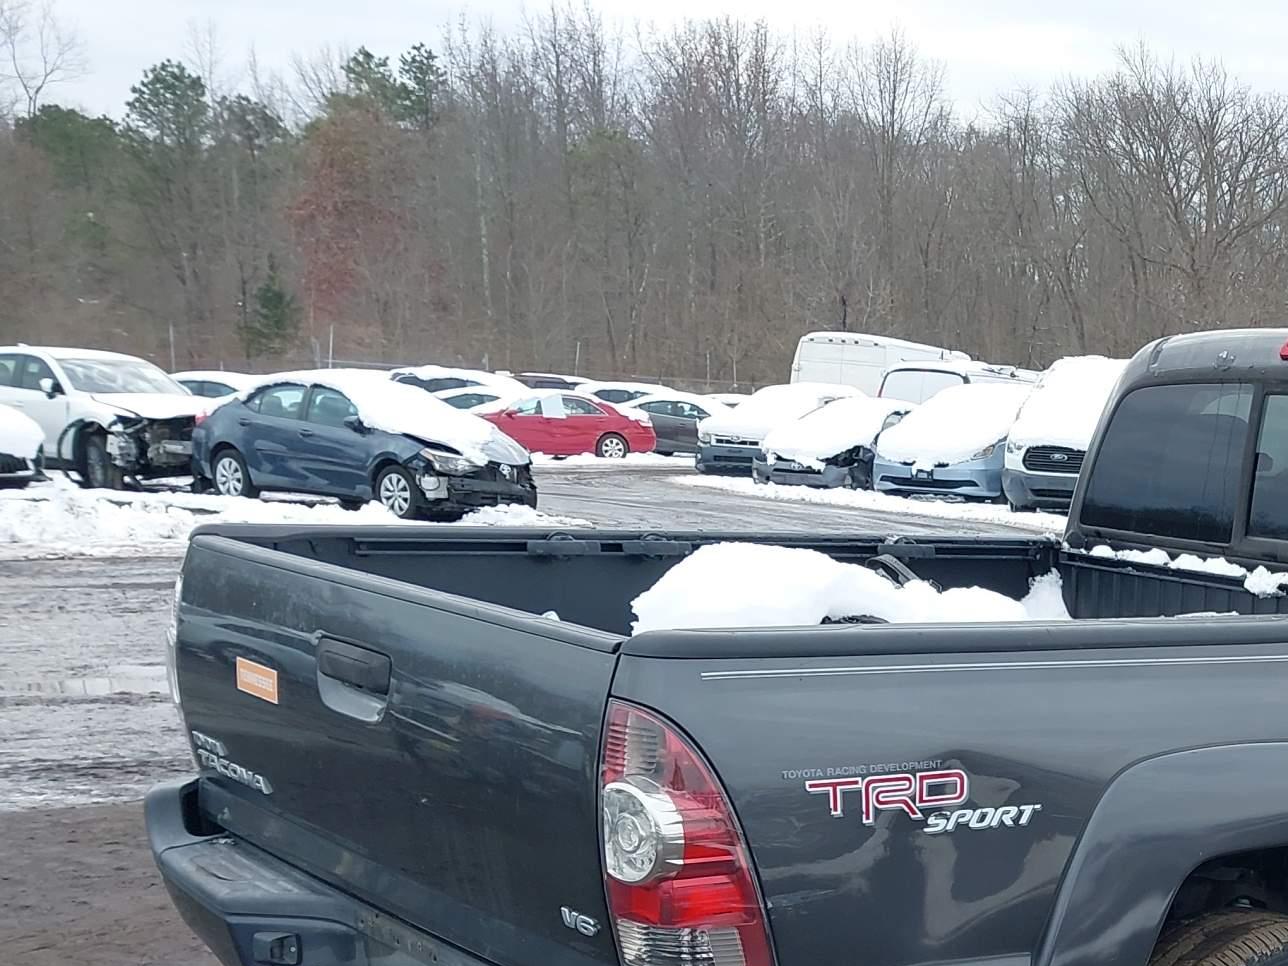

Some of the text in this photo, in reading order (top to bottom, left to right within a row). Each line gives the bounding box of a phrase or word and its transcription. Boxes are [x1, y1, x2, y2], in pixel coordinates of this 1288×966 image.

[197, 748, 273, 795] TACOMA
[781, 759, 943, 780] TOYOTA RACING DEVELOPMENT
[805, 769, 968, 825] TRD
[923, 804, 1042, 835] SPORT
[560, 906, 600, 937] V6
